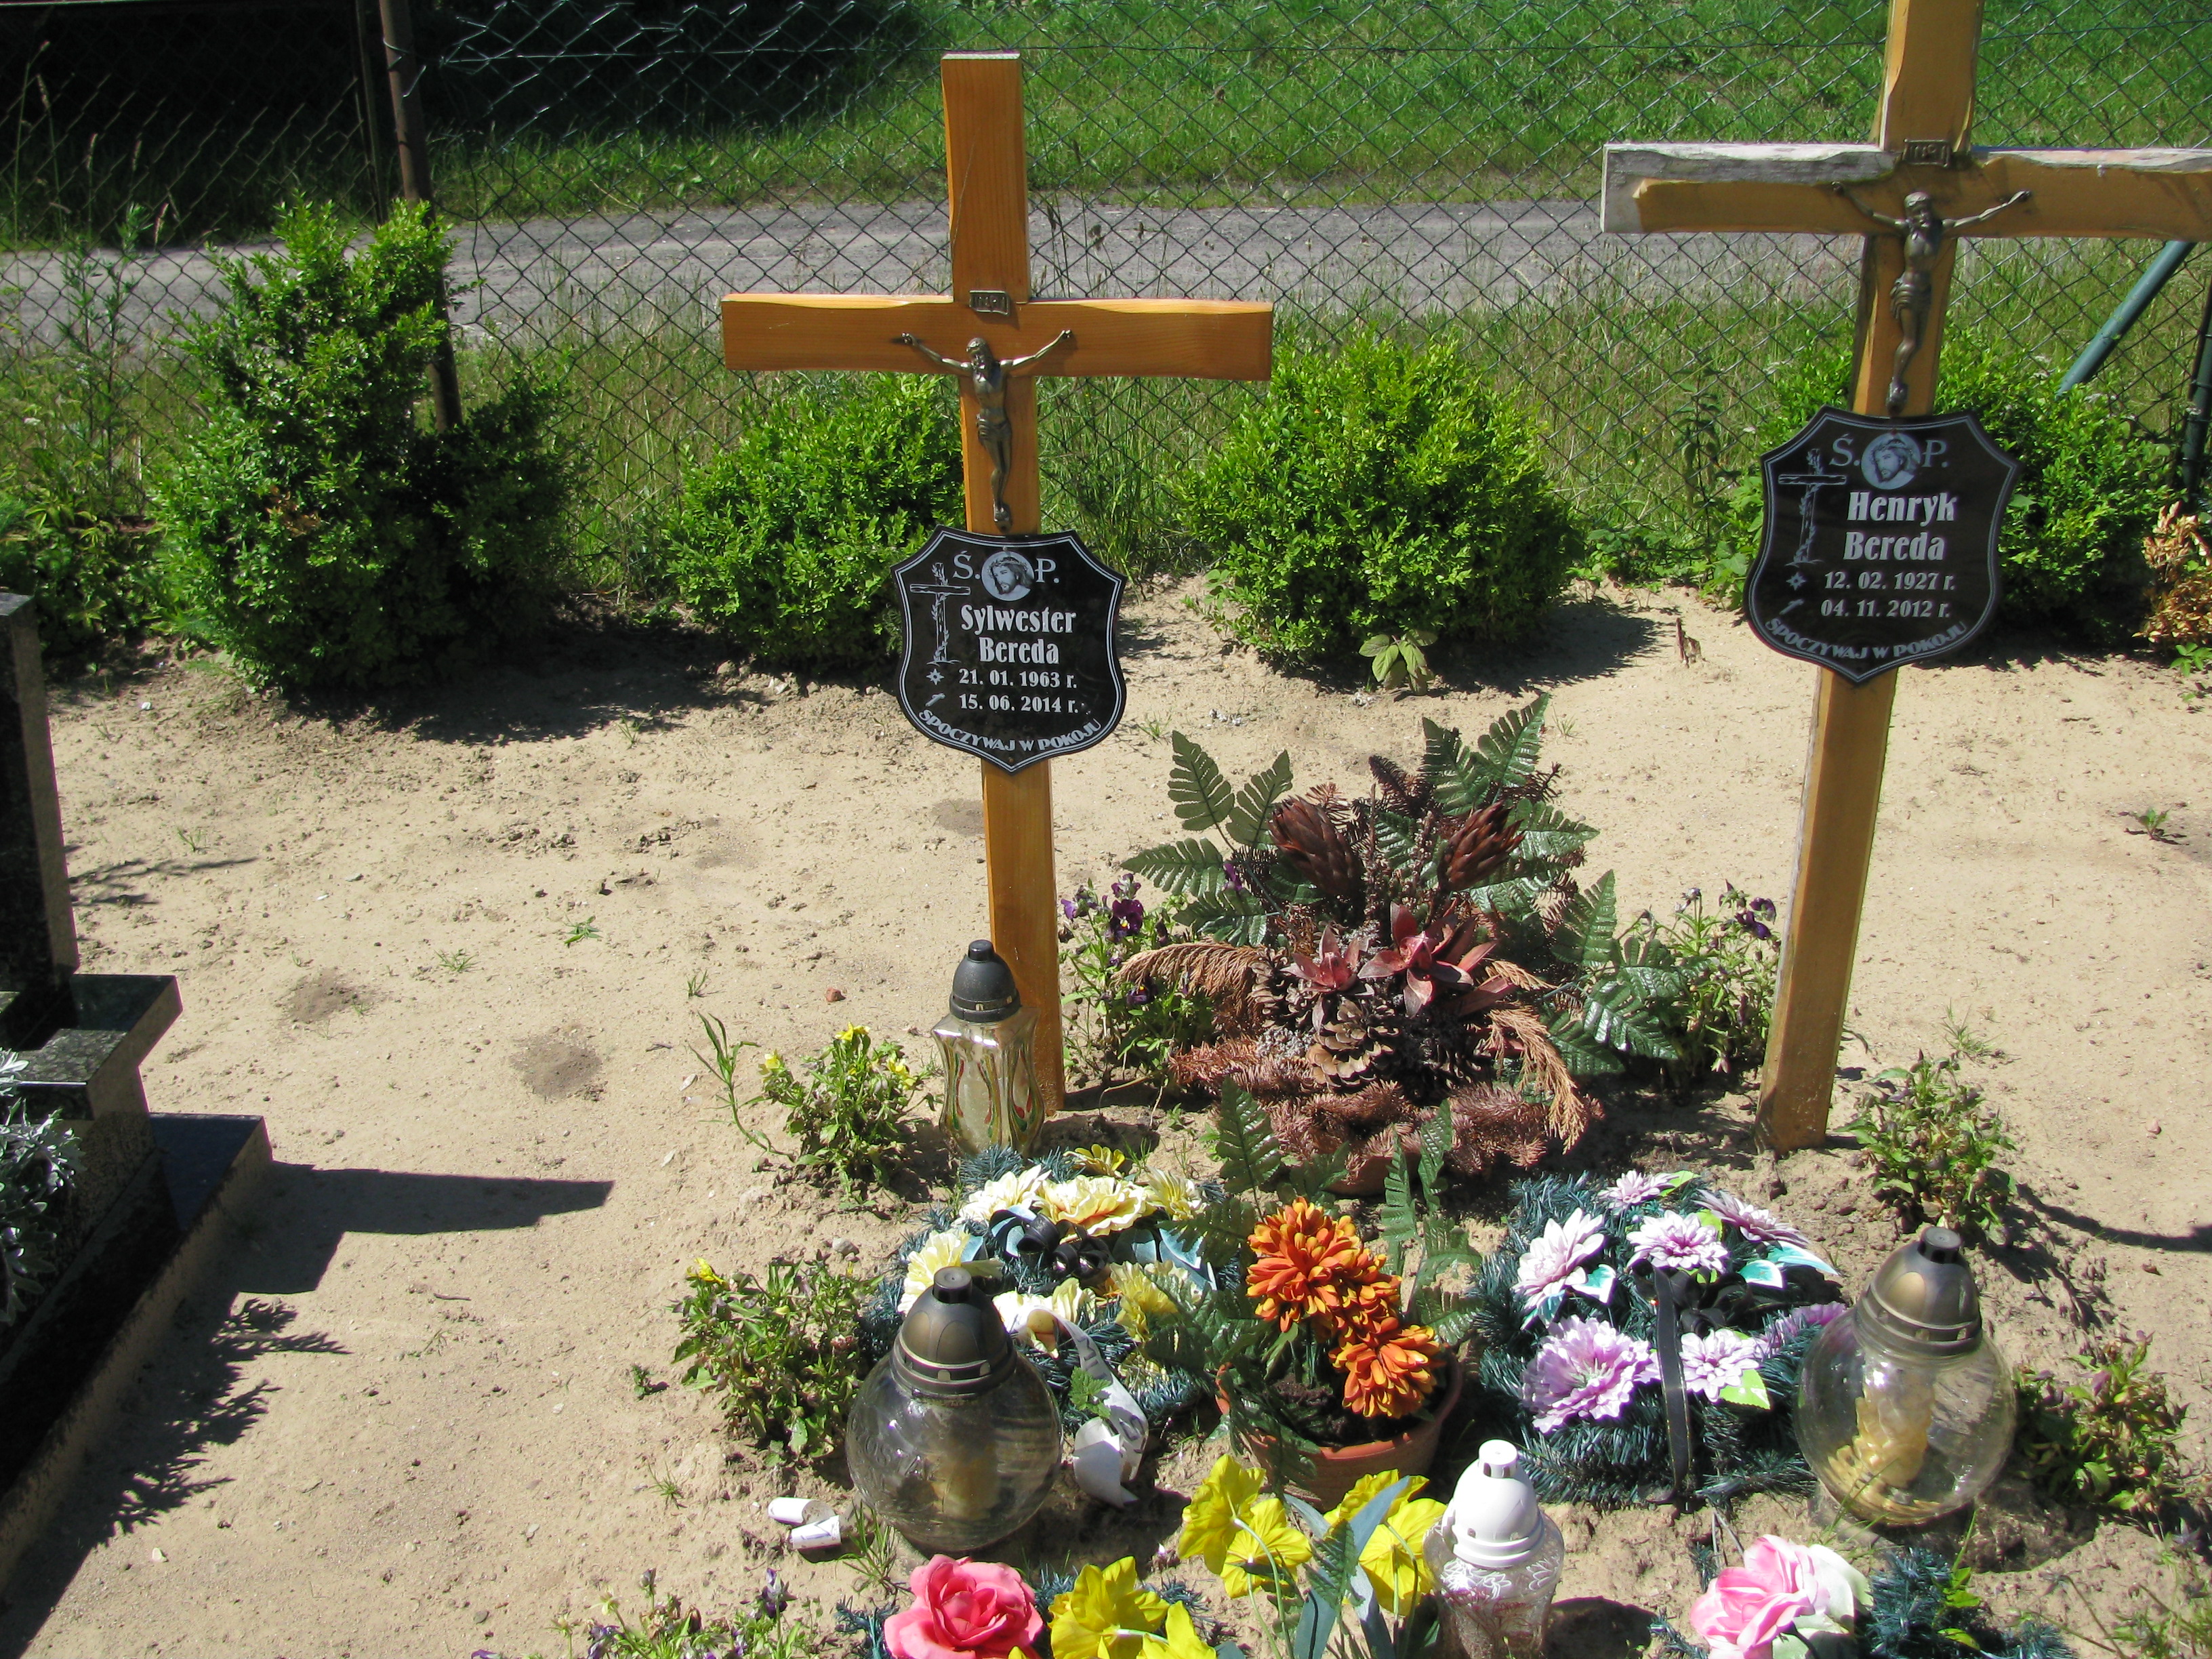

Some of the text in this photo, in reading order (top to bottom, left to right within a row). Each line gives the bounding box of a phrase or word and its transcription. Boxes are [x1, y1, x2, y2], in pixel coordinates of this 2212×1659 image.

[1828, 434, 1948, 468] Ś. P.
[1847, 491, 1958, 527] Henryk
[1843, 531, 1945, 560] Bereda
[952, 550, 1059, 583] Ś. P.
[1824, 571, 1955, 590] 12. 02. 1927 r.
[960, 605, 1076, 635] Sylwester
[1820, 599, 1950, 618] 04. 11. 2012 r.
[979, 637, 1059, 664] Bereda
[1765, 618, 1967, 659] SPOCZYWAJ W POKOJU
[959, 668, 1077, 689] 21. 01. 1963 r.
[959, 693, 1078, 713] 15. 06. 2014 r.
[919, 709, 1102, 751] SPOCZYWAJ W POKOJU
